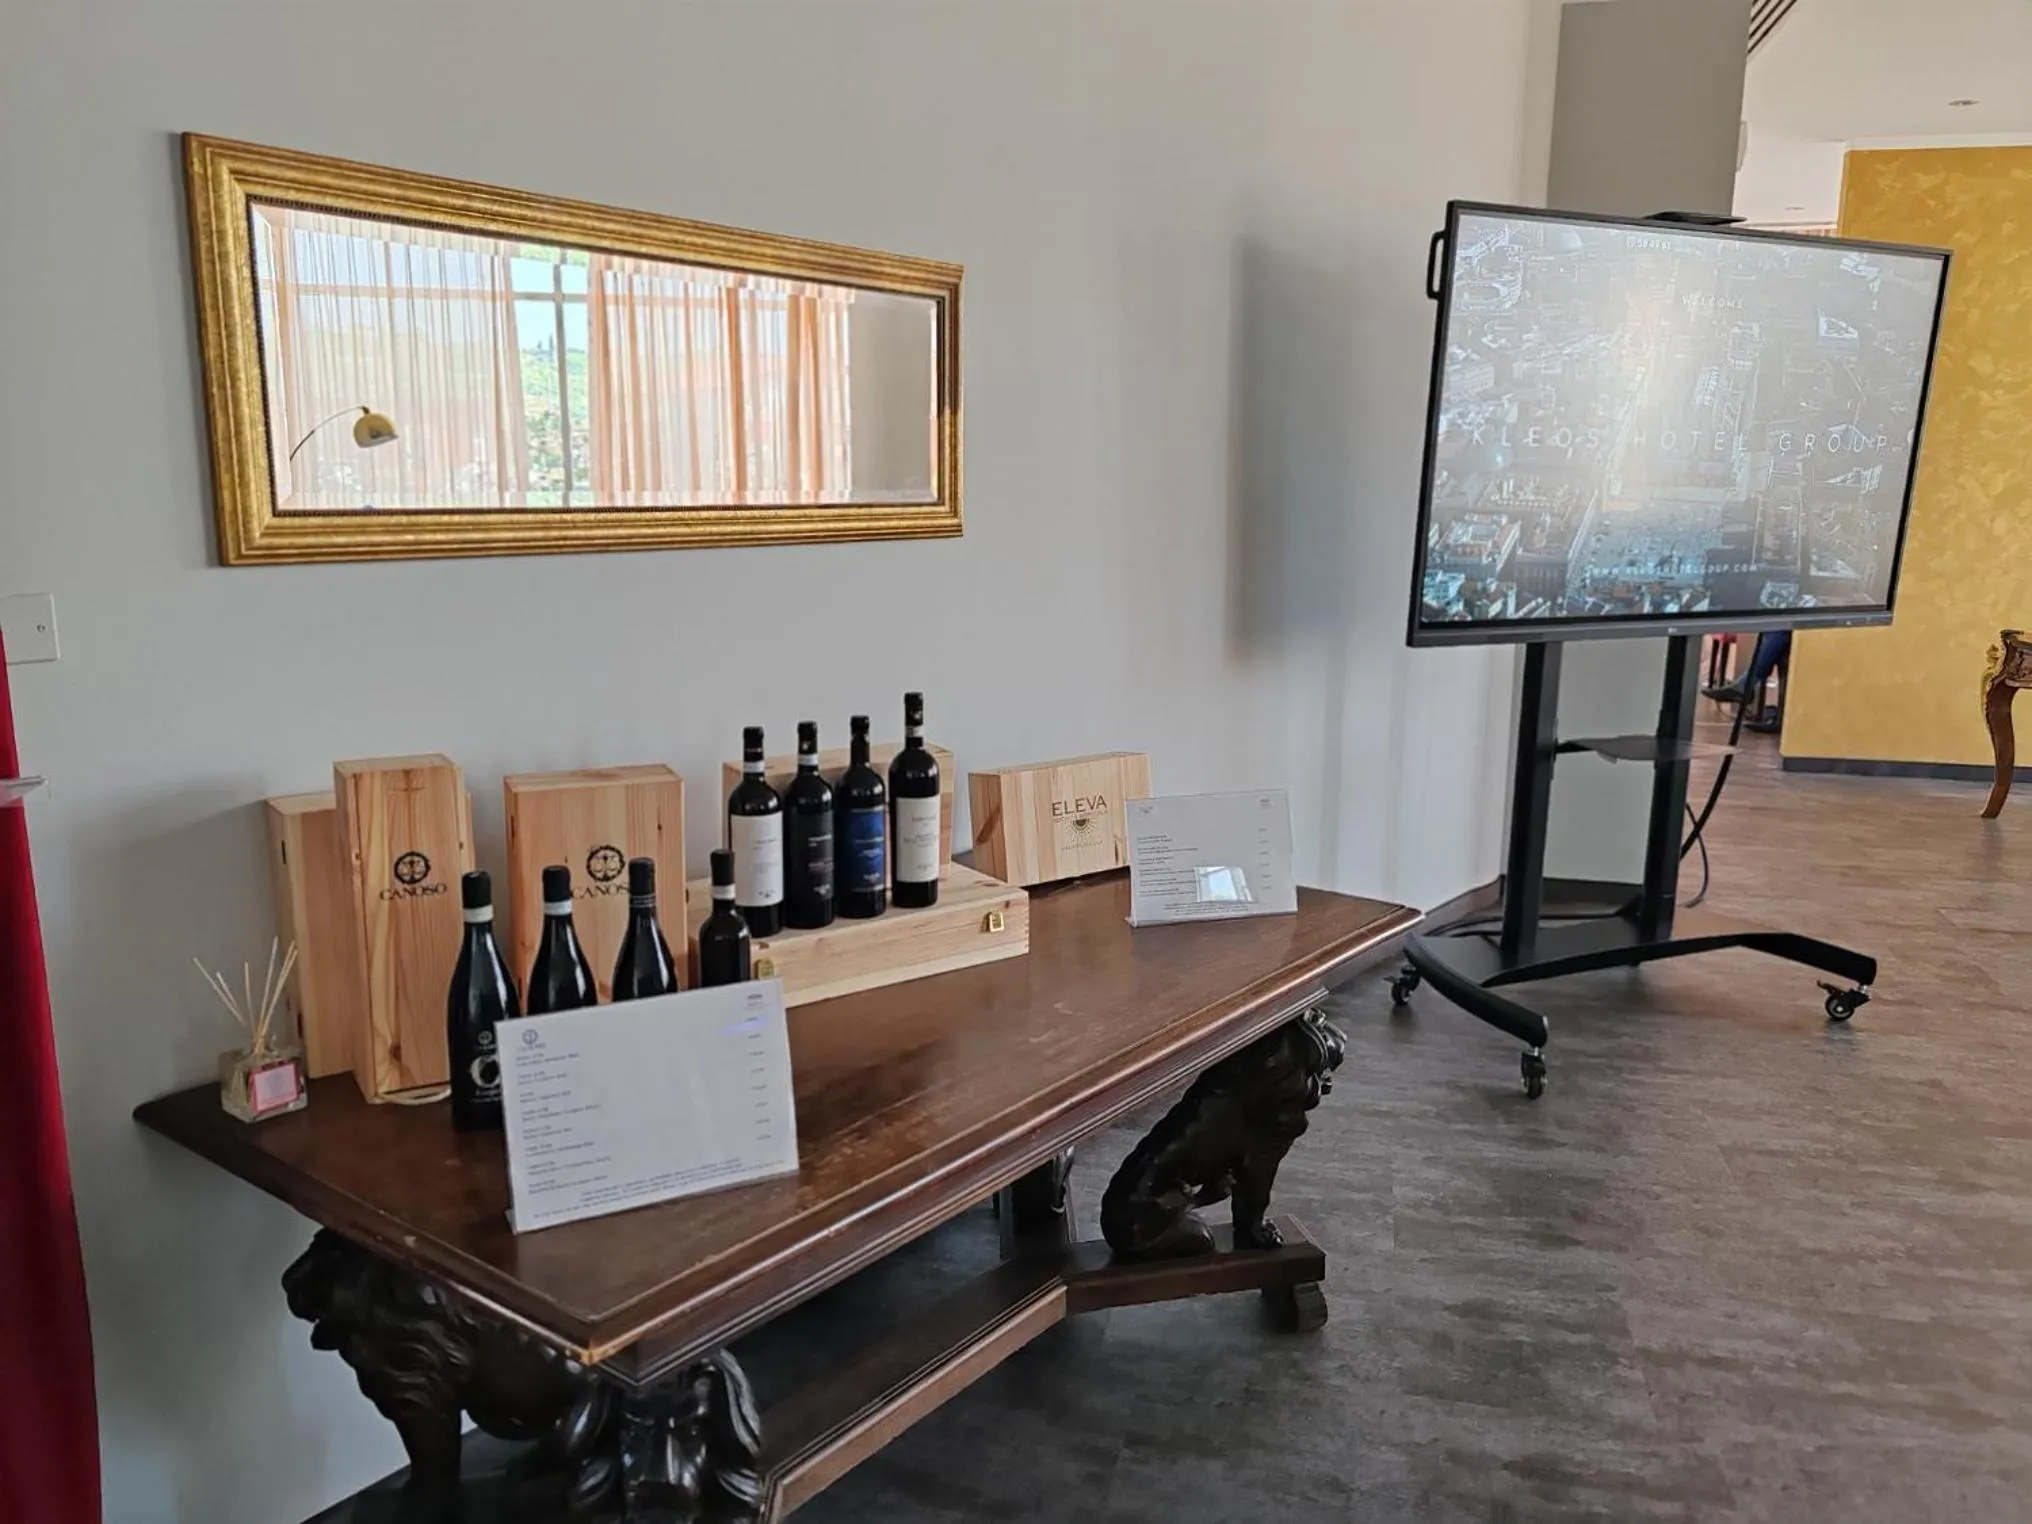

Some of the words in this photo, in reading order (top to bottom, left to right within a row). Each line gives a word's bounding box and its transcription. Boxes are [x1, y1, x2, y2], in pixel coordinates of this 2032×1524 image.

[1472, 426, 1600, 449] KLEOS
[1634, 429, 1748, 451] HOTEL
[1779, 432, 1888, 453] GROUP
[1051, 794, 1108, 817] ELEVA
[379, 882, 447, 901] CANOSO
